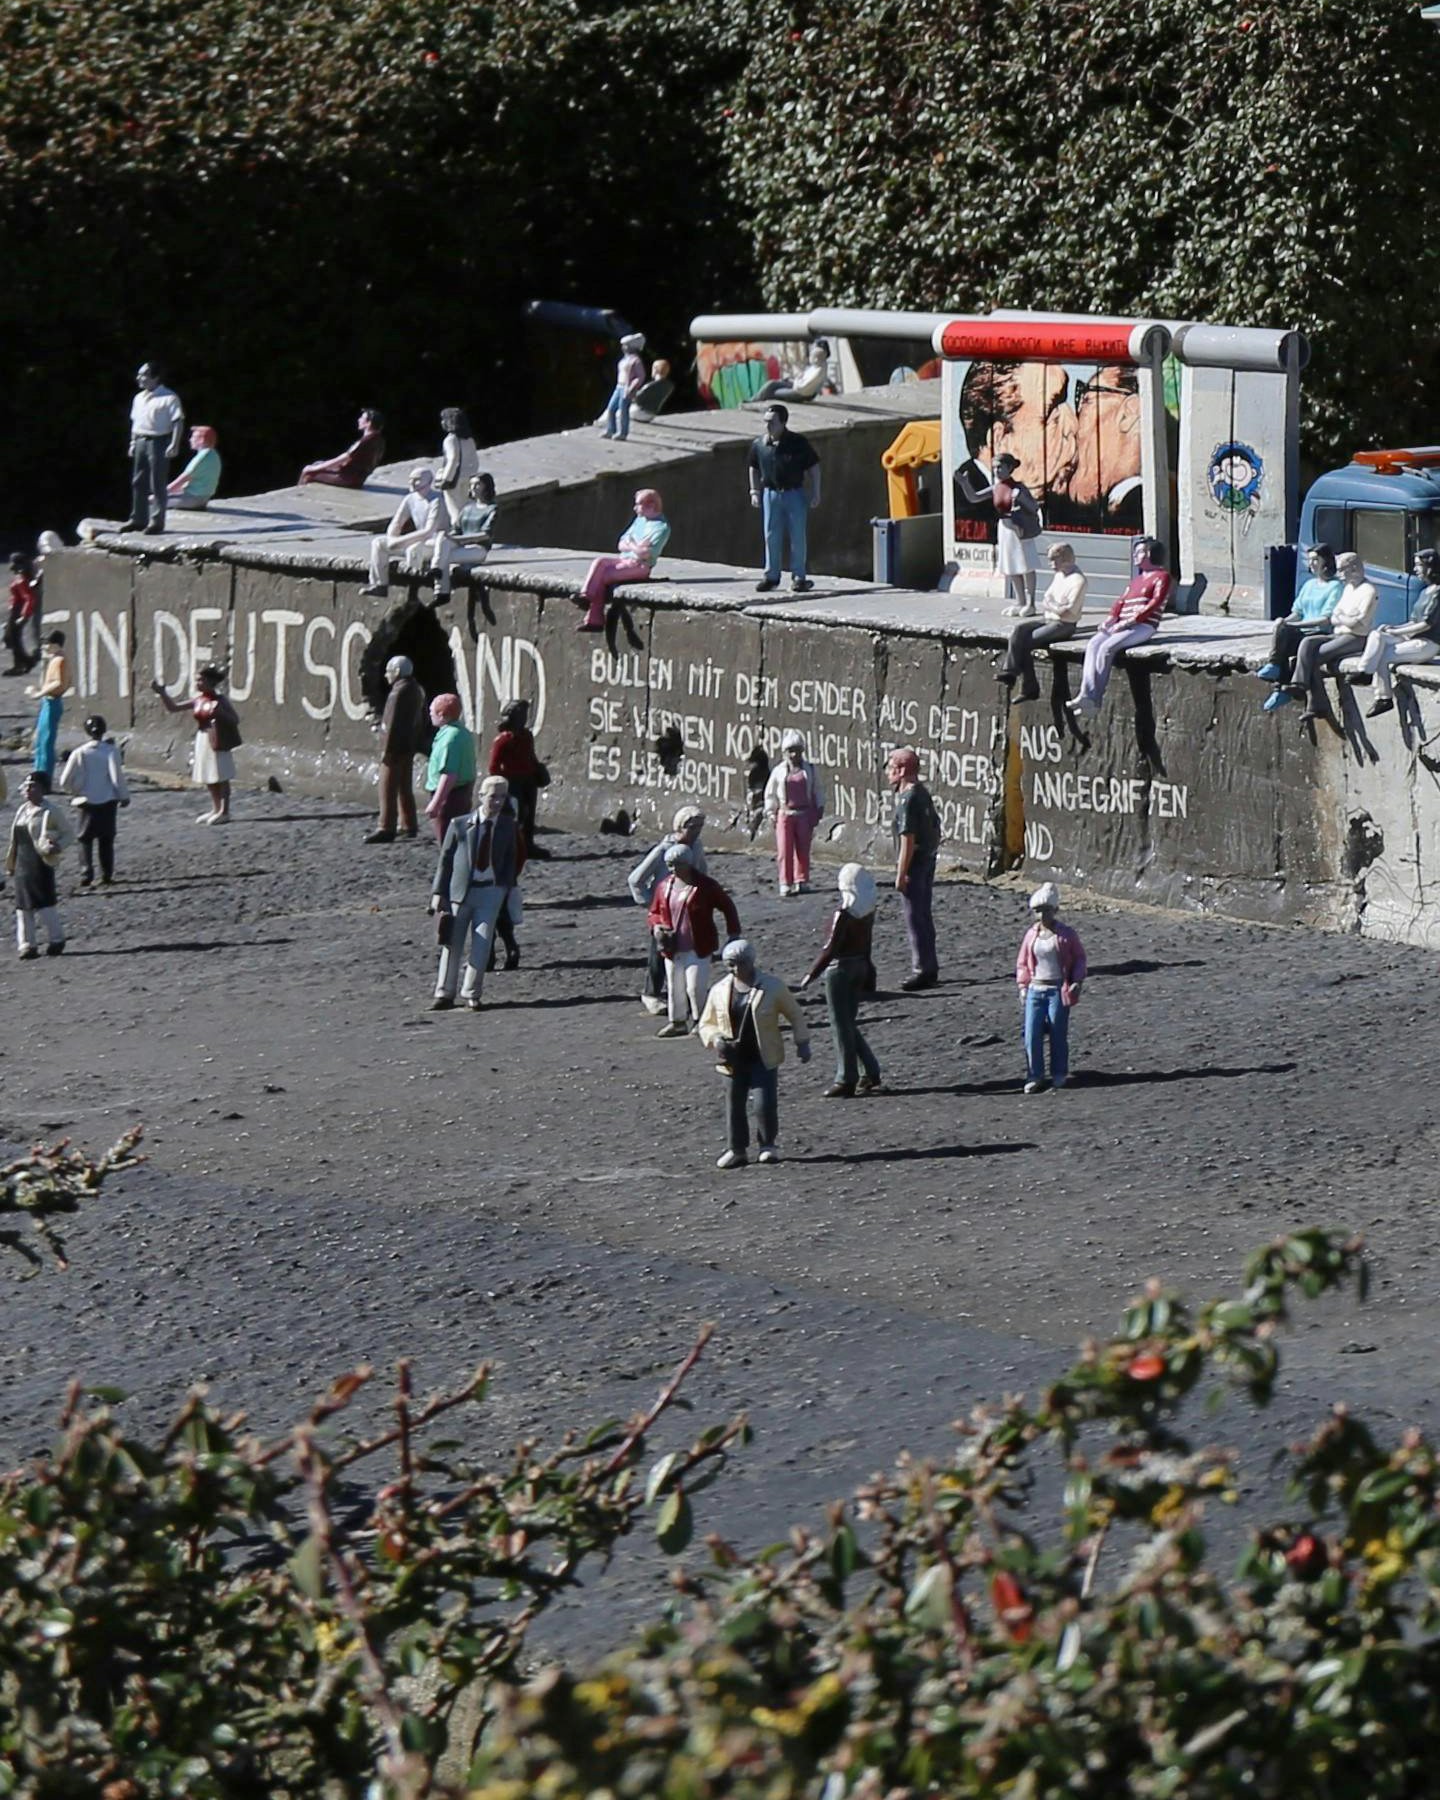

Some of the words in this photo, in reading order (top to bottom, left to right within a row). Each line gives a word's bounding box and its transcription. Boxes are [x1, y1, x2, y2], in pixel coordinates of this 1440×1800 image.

[591, 649, 673, 691] BULLEN
[788, 680, 867, 722] SENDER
[879, 694, 919, 735] AUS
[928, 704, 979, 747] DEM
[588, 745, 621, 782] ES
